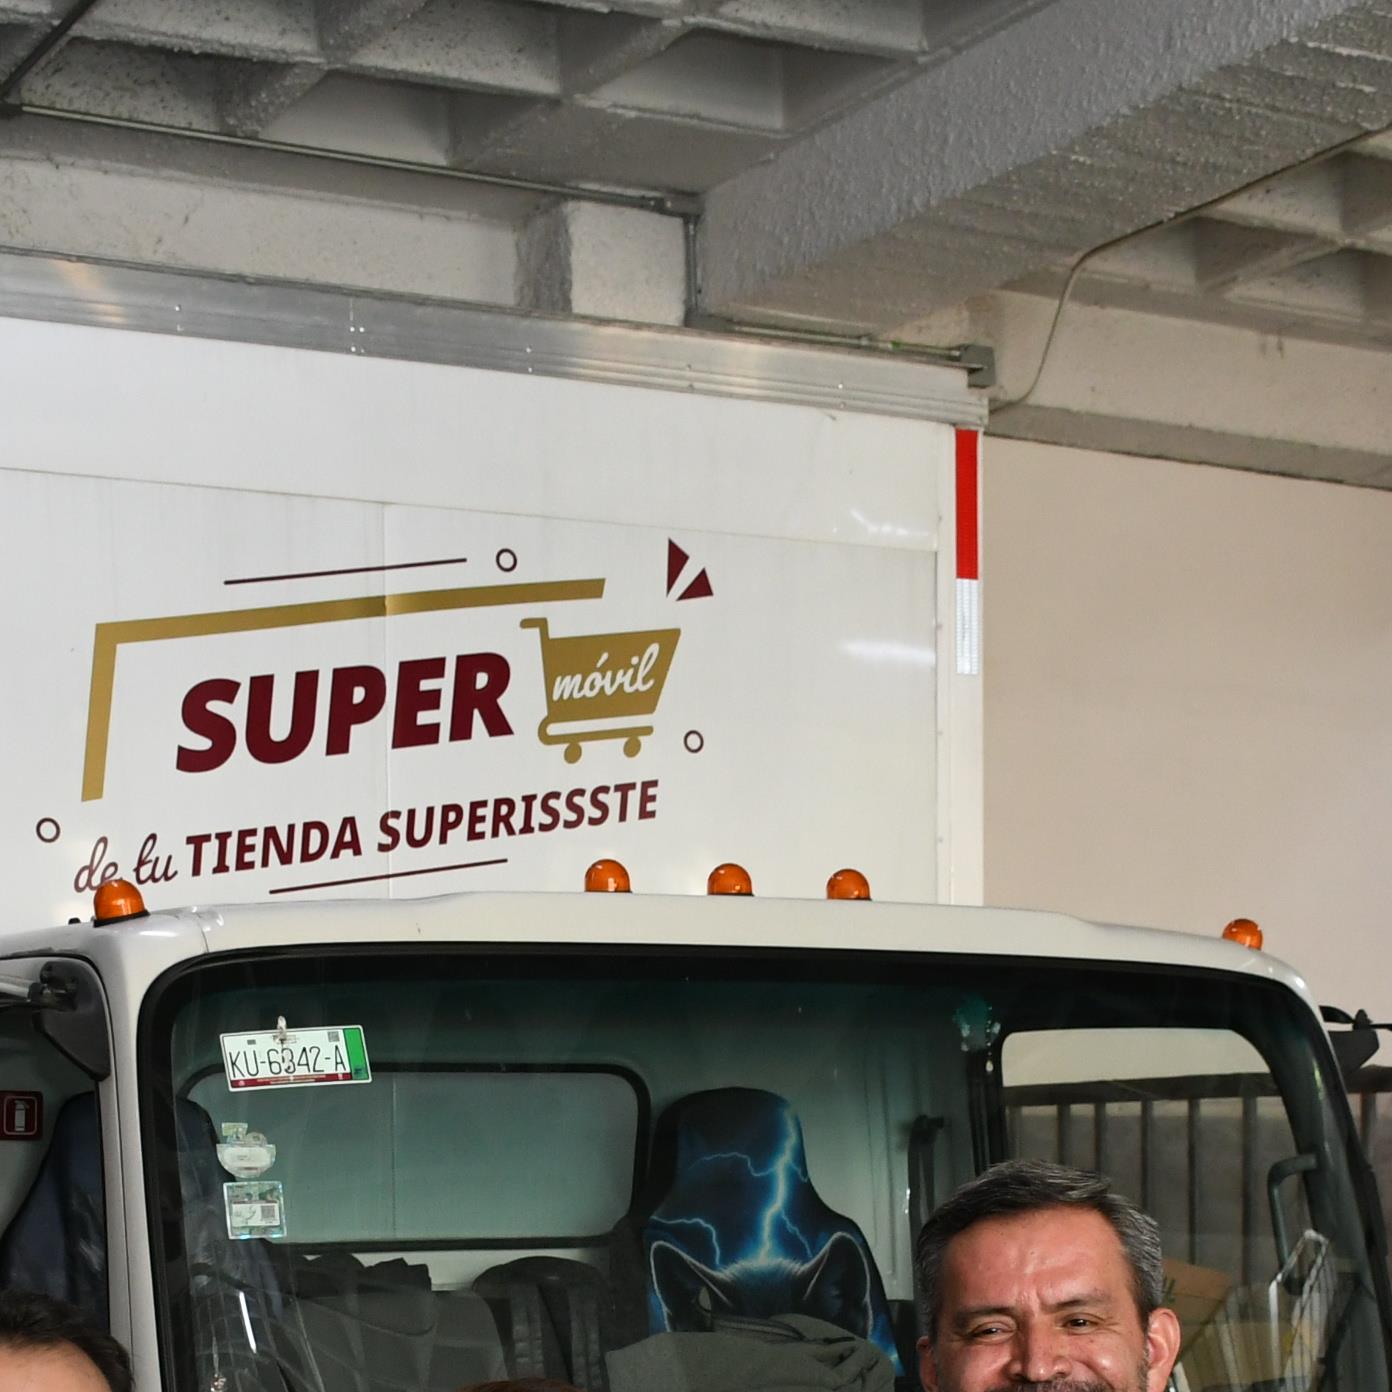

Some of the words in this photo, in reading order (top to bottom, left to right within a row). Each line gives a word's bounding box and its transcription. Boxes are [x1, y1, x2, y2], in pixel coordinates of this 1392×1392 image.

[176, 651, 515, 773] SUPER
[552, 642, 661, 702] móvil
[74, 836, 122, 893] de
[133, 833, 178, 885] tu
[185, 816, 363, 877] TIENDA
[377, 779, 659, 853] SUPERISSSTE
[228, 1044, 347, 1079] KU-6342-A
